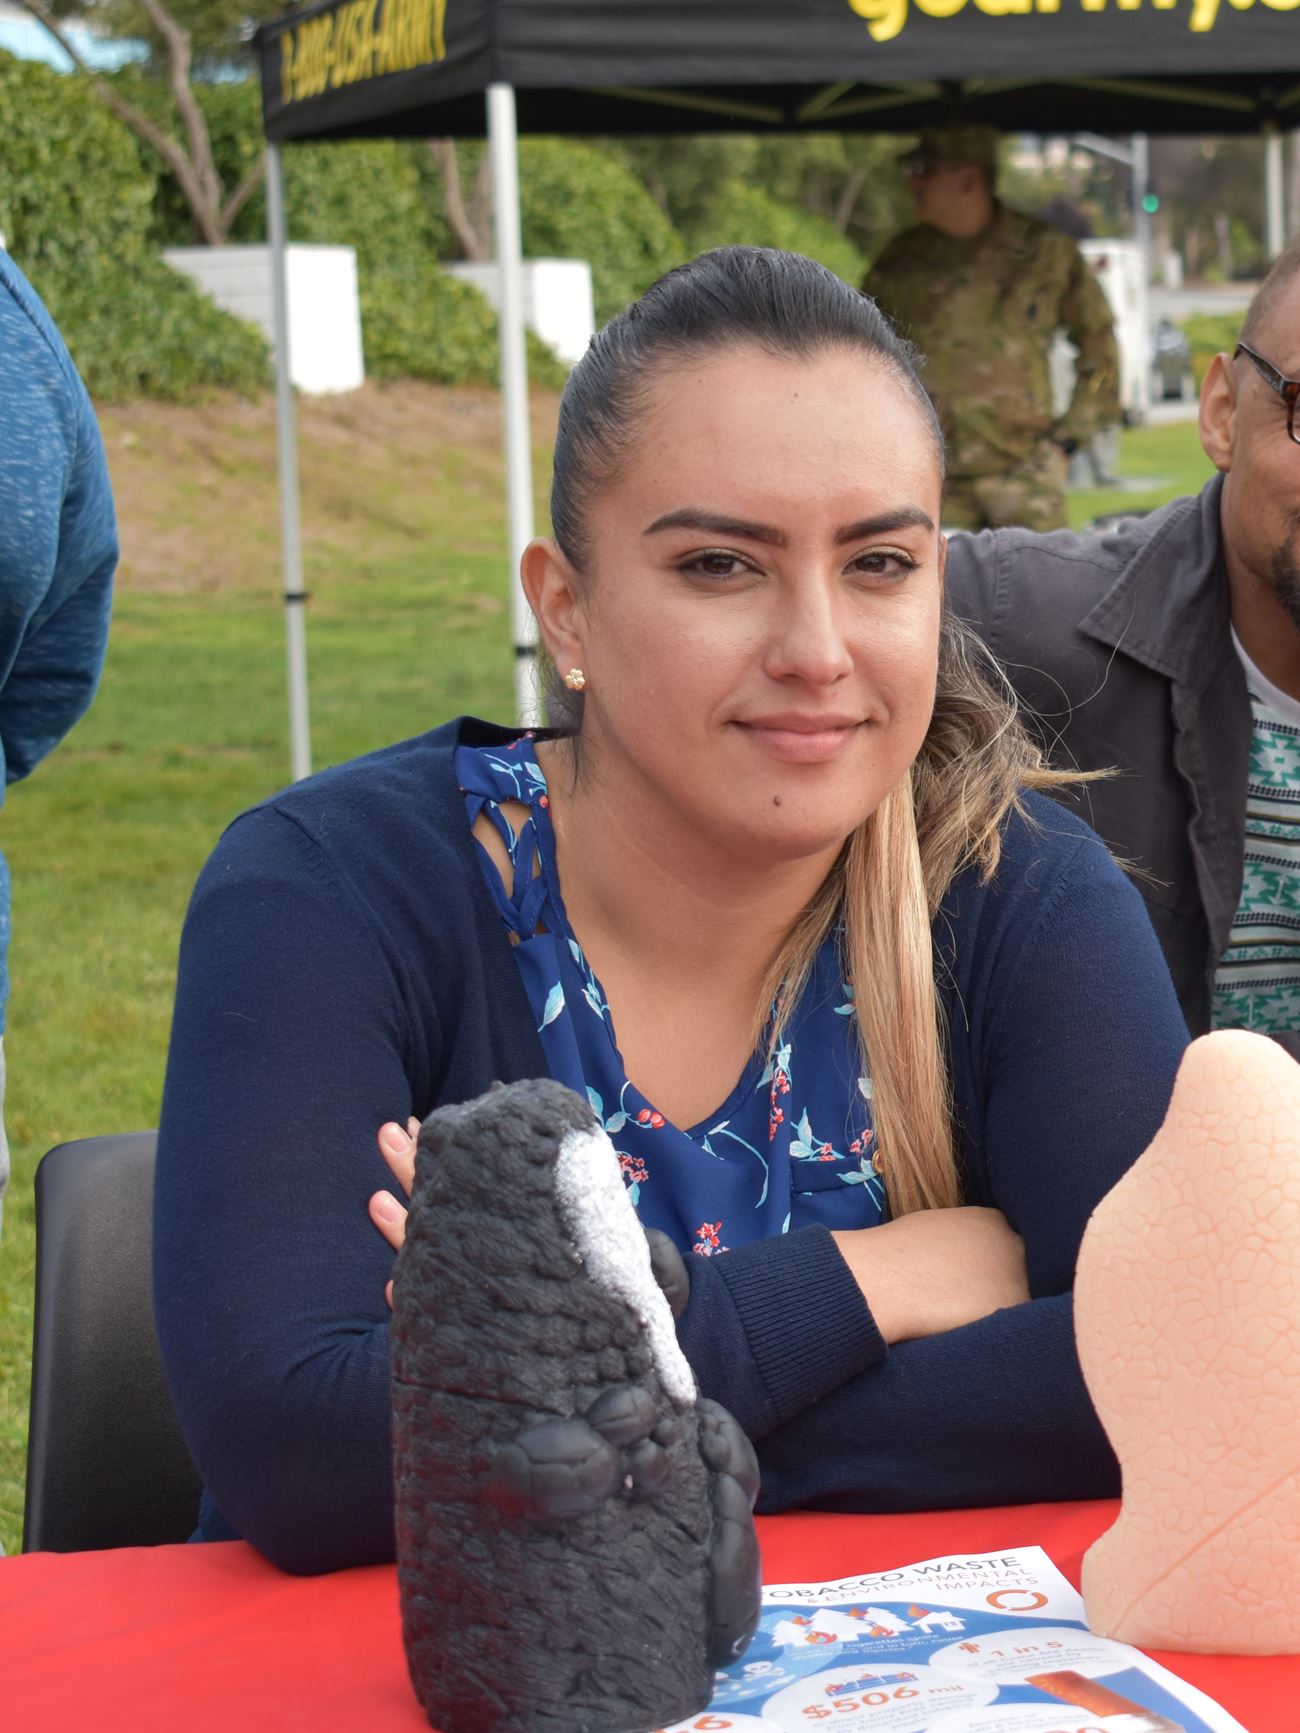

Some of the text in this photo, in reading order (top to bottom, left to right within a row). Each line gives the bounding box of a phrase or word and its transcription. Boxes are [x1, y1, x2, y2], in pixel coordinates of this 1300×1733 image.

[763, 1557, 1021, 1598] OBACCO WASTE
[826, 1568, 1033, 1601] ENVIRONMENTAL
[936, 1577, 1039, 1591] IMPACTS
[1013, 1645, 1039, 1654] in
[802, 1686, 920, 1719] $506
